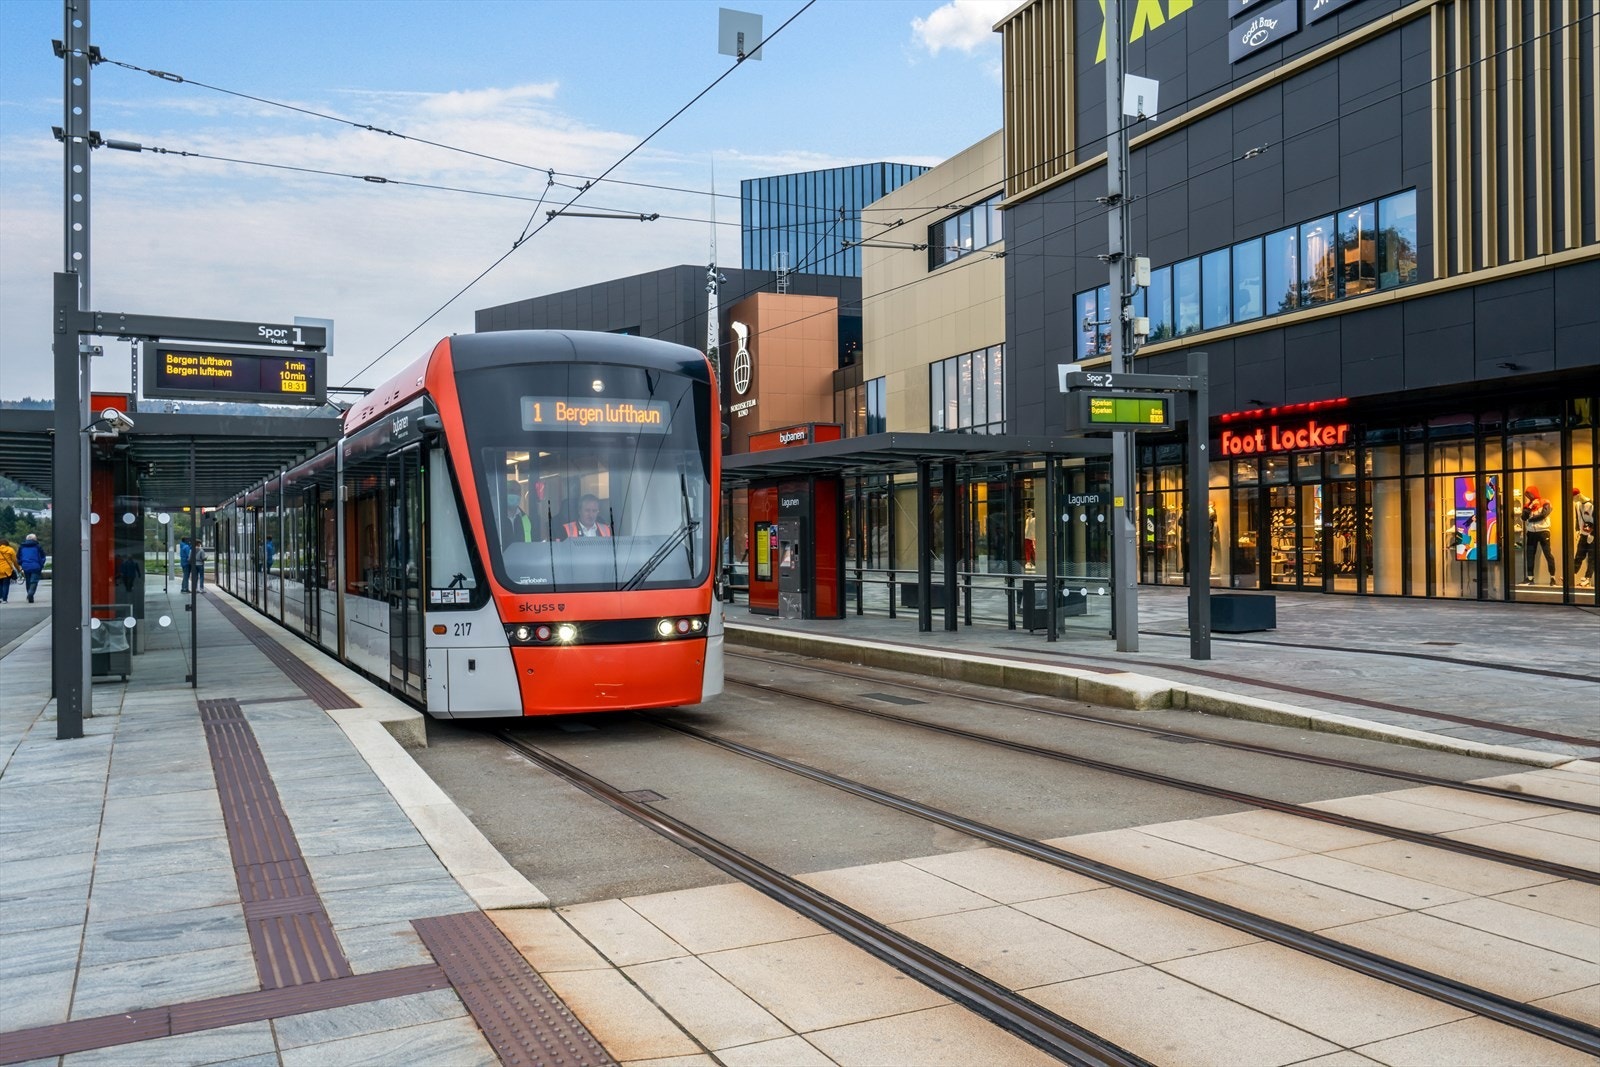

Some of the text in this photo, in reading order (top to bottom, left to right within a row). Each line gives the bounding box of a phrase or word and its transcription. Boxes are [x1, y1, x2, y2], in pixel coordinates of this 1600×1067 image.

[258, 326, 306, 345] Spor 1
[166, 354, 232, 366] Bergen lufthavn
[285, 361, 306, 371] 1 min
[166, 365, 232, 377] Bergen lufthavn
[280, 371, 306, 381] 10 min
[283, 382, 305, 390] 18:31
[1086, 373, 1113, 387] Spor 2
[534, 402, 660, 426] 1 Bergen lufthavn
[779, 431, 805, 445] bybanen
[1221, 420, 1349, 455] Foot Locker
[781, 498, 800, 508] Lagunen
[1068, 494, 1099, 507] Lagunen
[519, 602, 555, 614] skyss
[454, 622, 472, 637] 217
